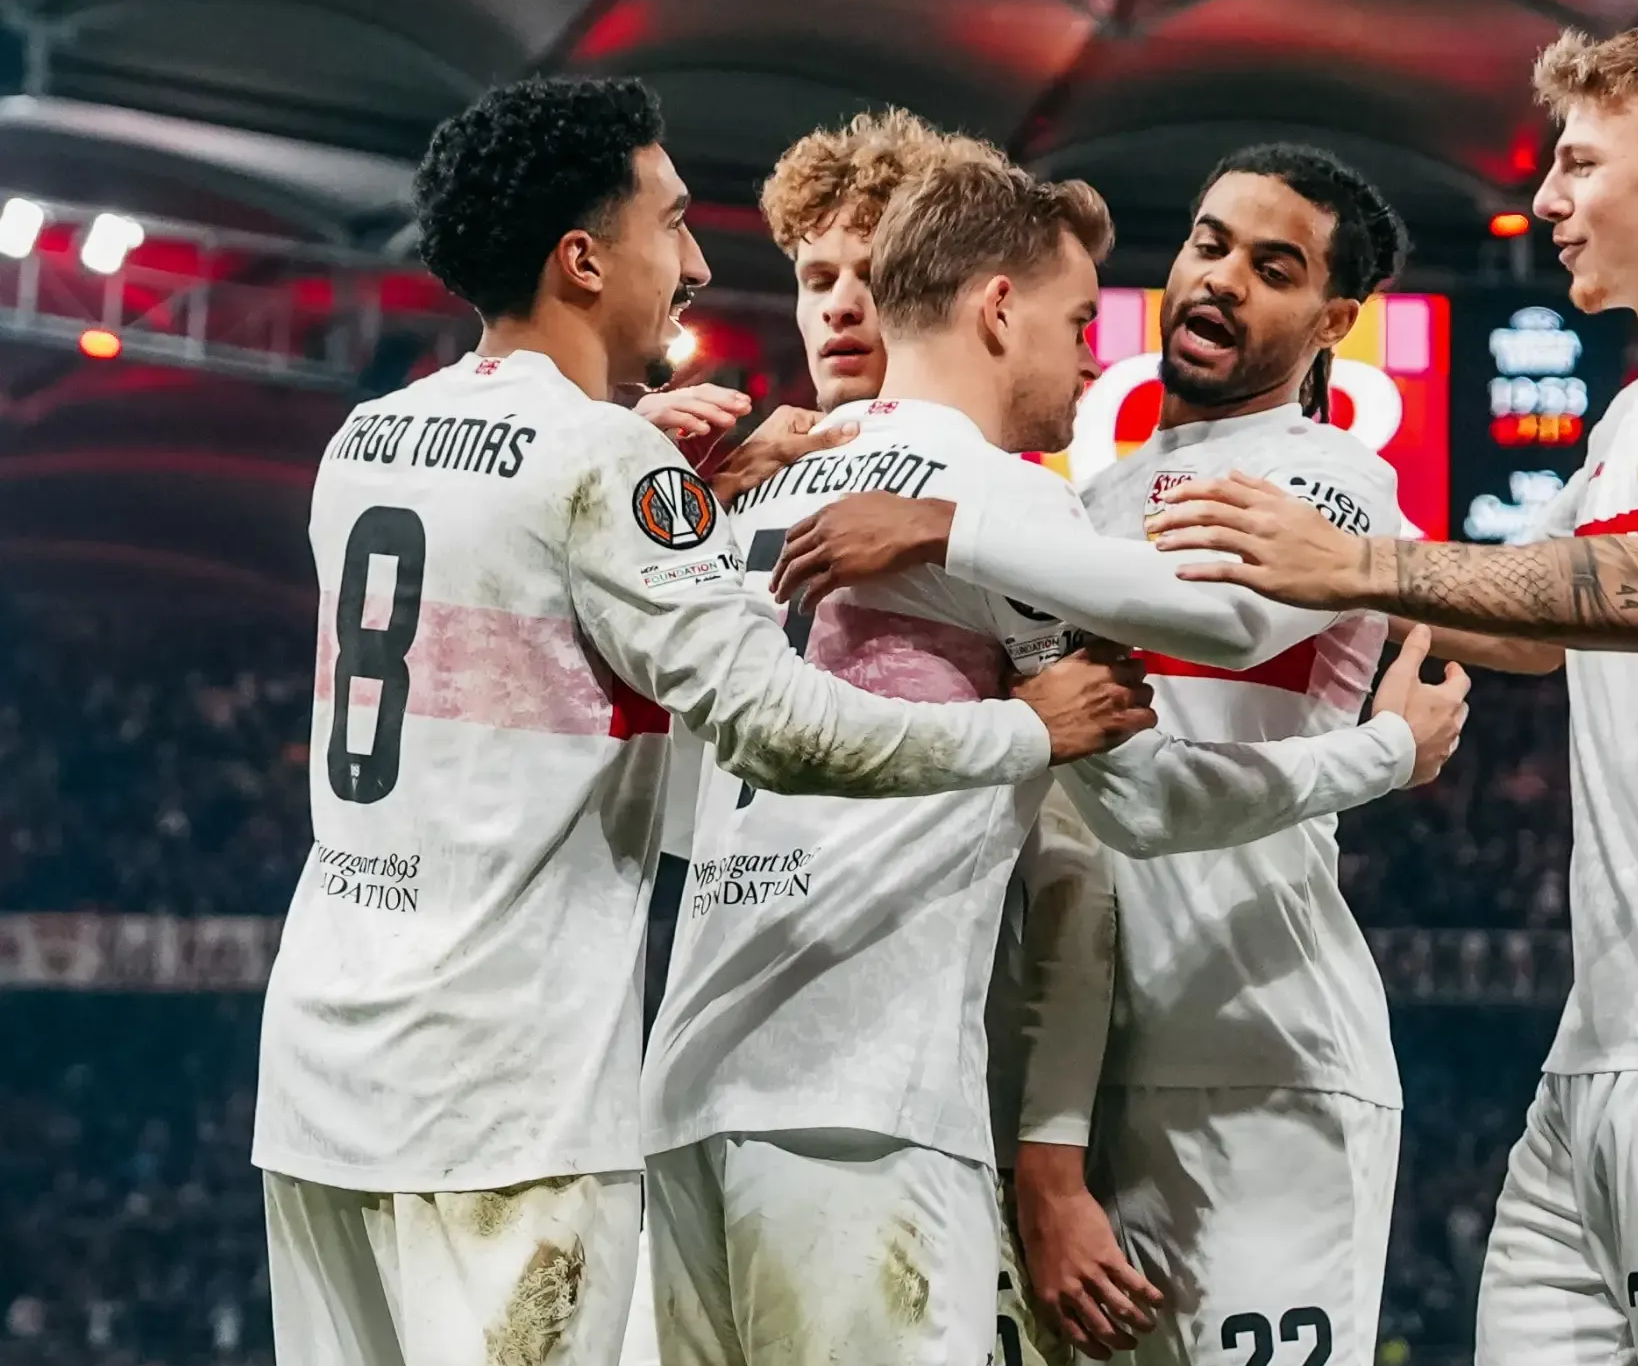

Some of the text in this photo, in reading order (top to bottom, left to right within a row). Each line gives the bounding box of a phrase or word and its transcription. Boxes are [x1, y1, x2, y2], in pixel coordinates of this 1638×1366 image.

[411, 413, 537, 478] TOMÁS
[327, 505, 426, 804] 8
[322, 872, 420, 913] DATION
[379, 853, 421, 883] 1893
